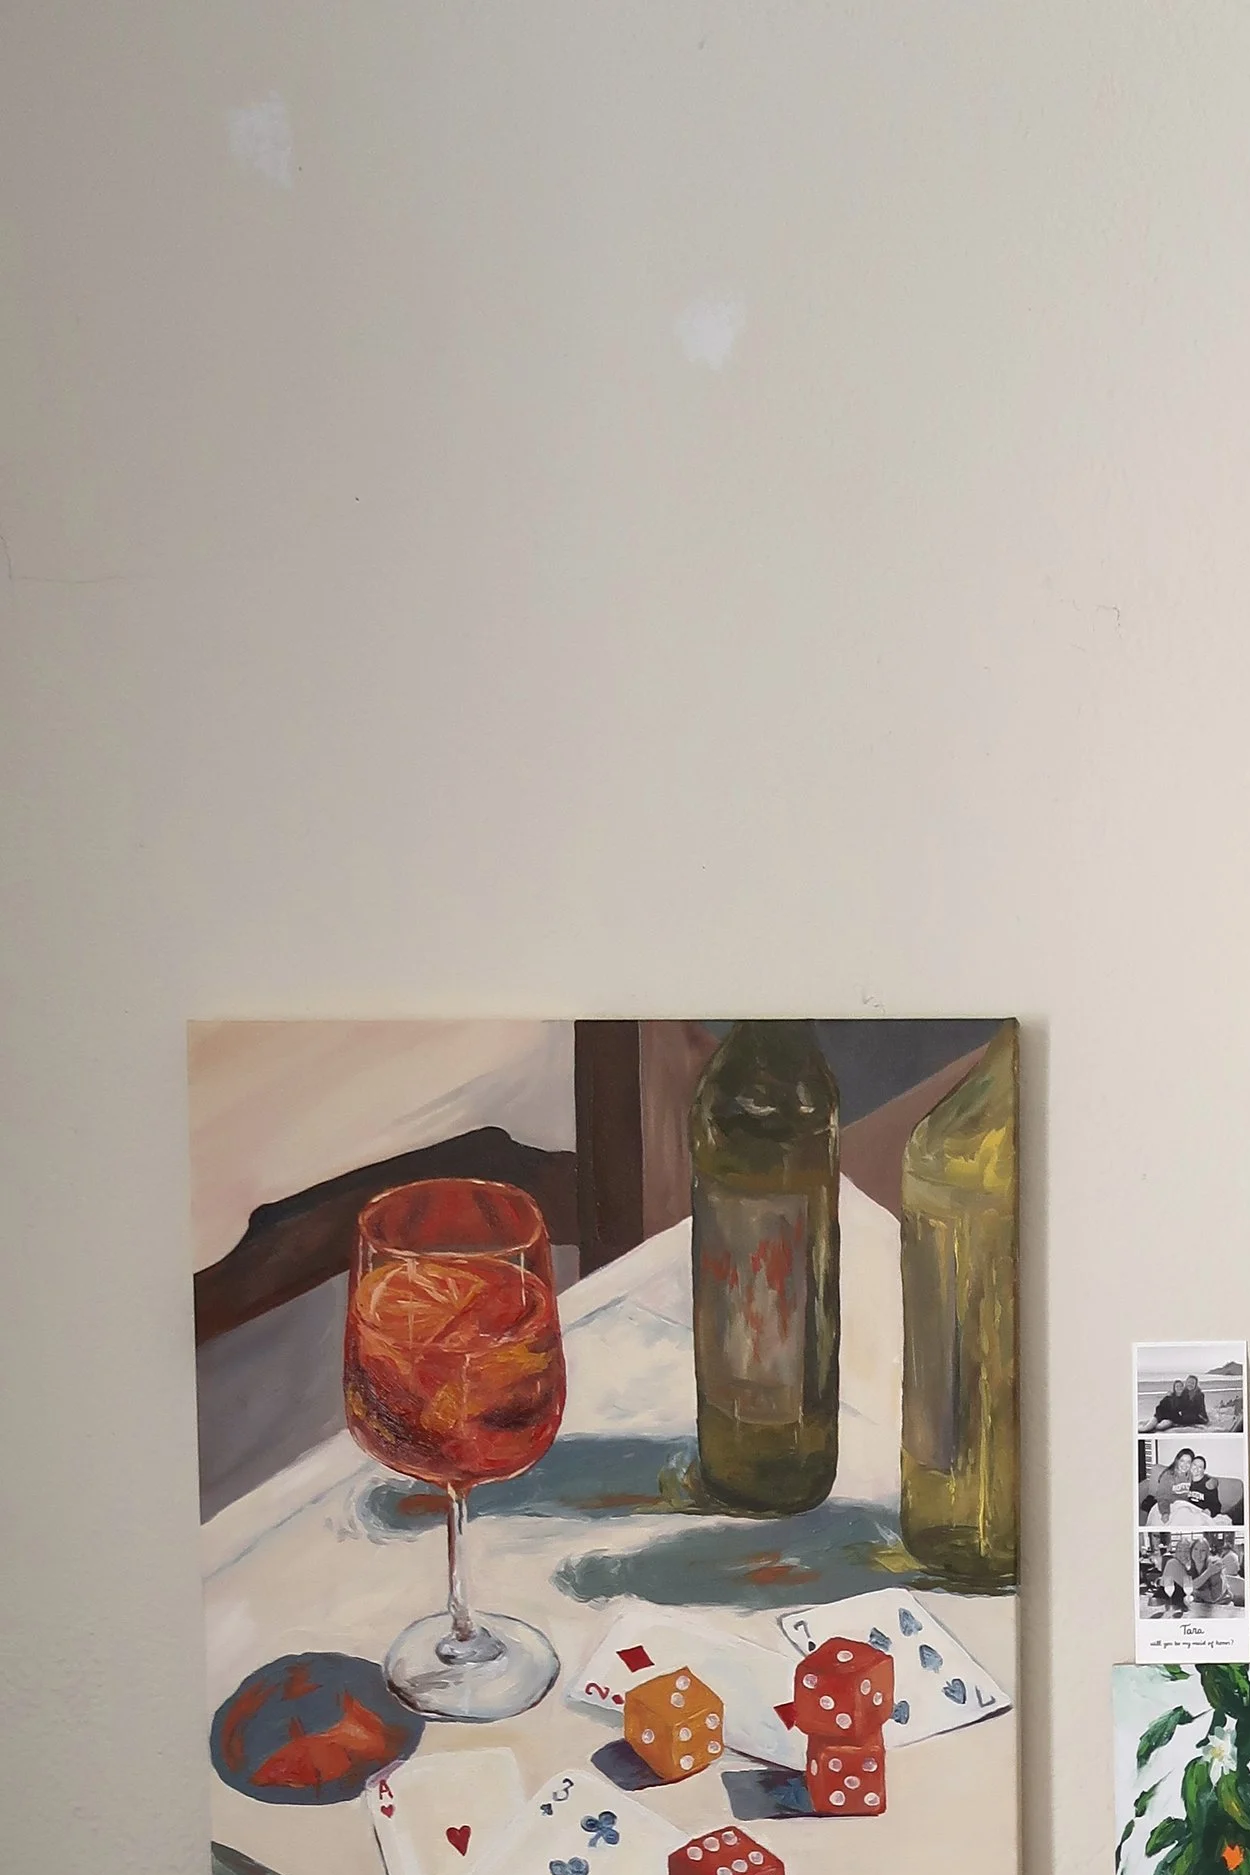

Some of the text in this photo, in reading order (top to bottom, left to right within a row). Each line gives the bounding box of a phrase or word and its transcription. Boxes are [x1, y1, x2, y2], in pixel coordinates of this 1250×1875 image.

[793, 1620, 811, 1639] 7
[1180, 1624, 1204, 1635] Tara
[1207, 1640, 1214, 1648] of
[585, 1682, 611, 1700] 2
[975, 1685, 996, 1708] 7
[378, 1780, 394, 1799] A
[552, 1778, 574, 1801] 3
